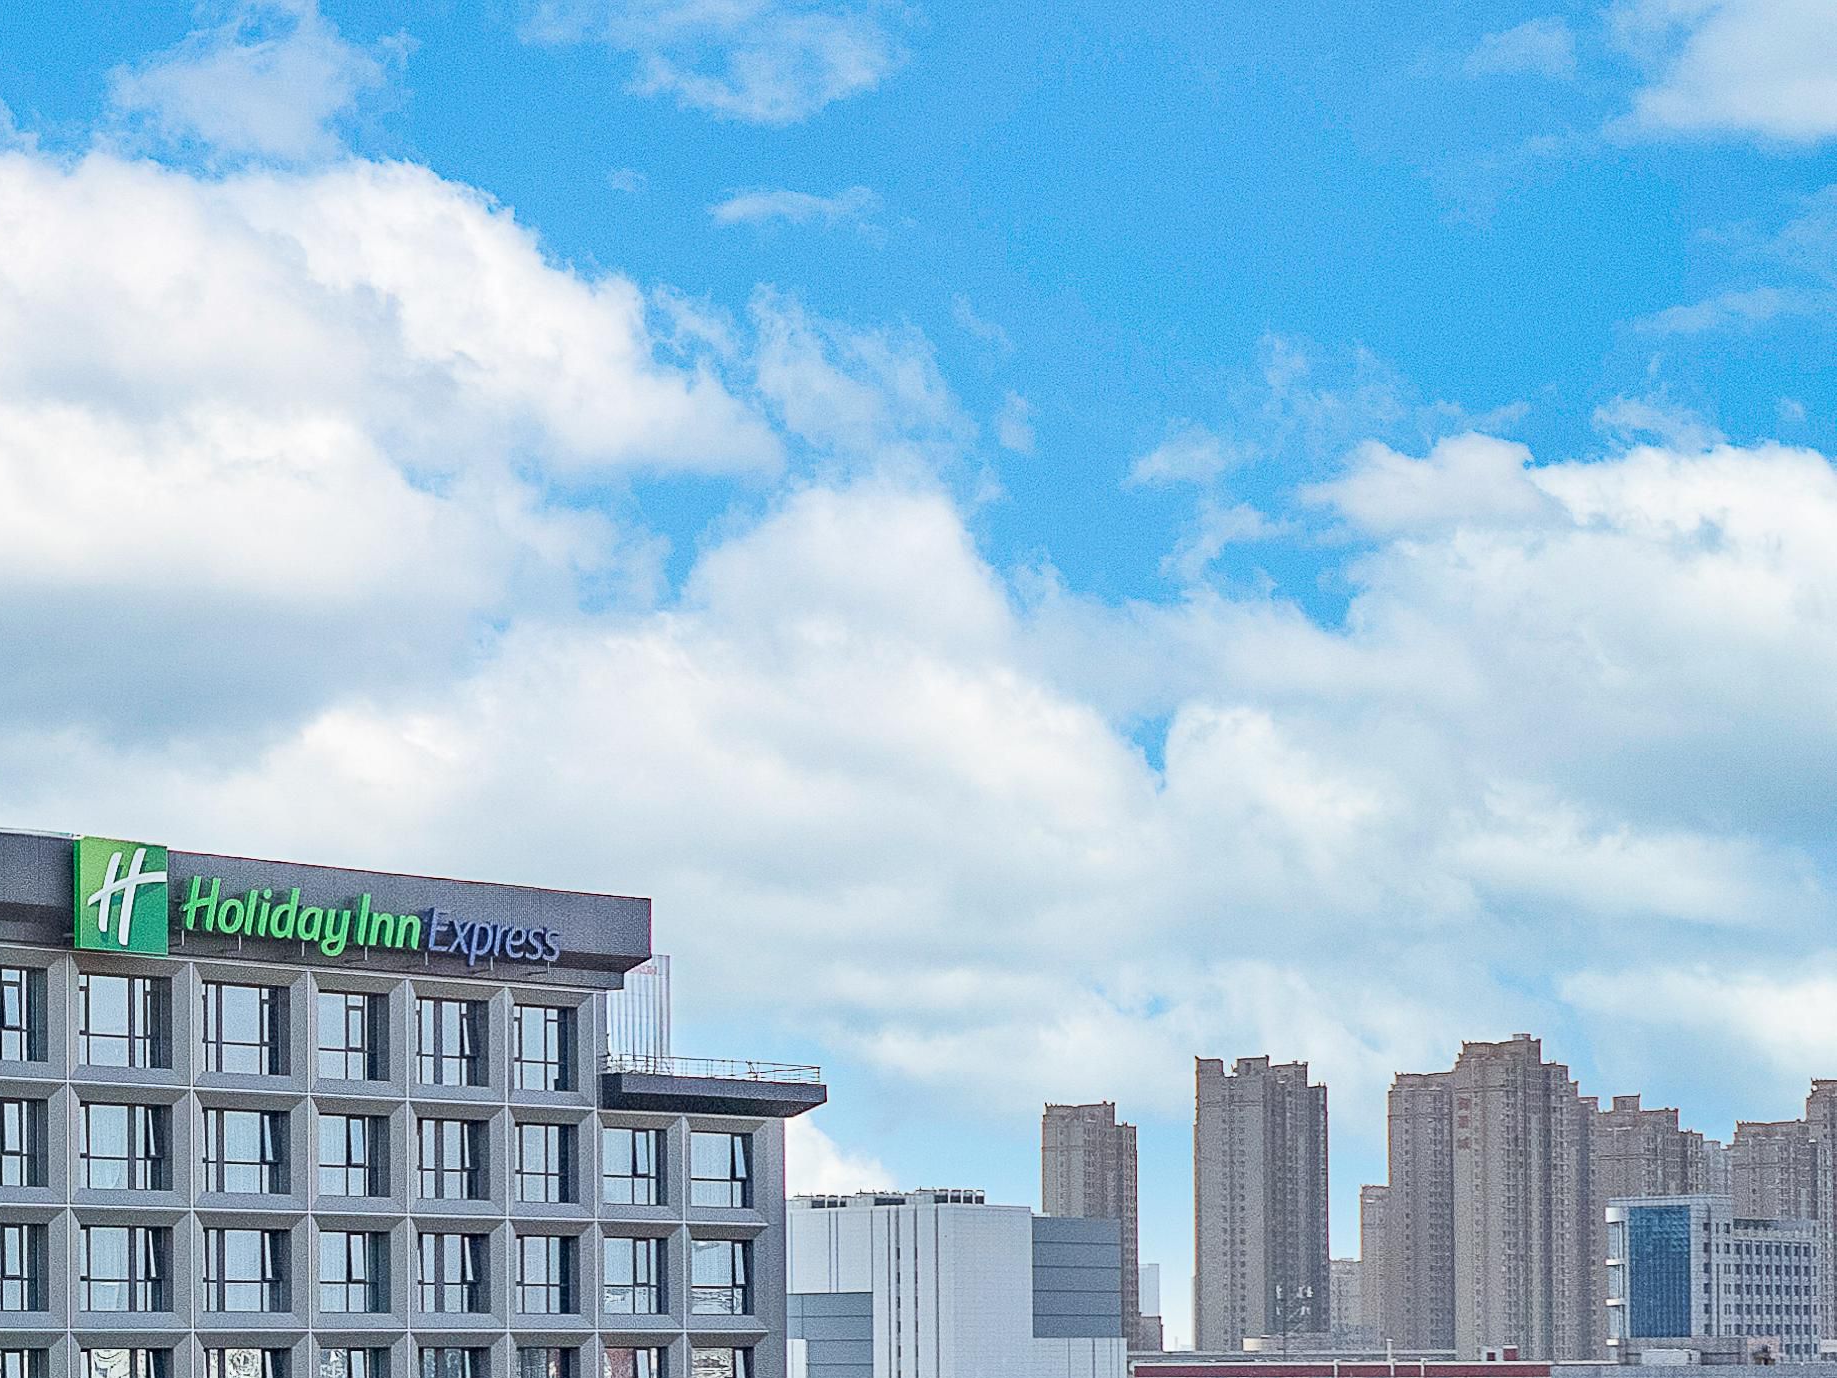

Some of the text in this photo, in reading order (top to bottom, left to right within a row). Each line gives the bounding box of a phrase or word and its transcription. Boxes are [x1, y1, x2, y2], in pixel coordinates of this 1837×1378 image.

[181, 874, 561, 968] Holiday Inn Express
